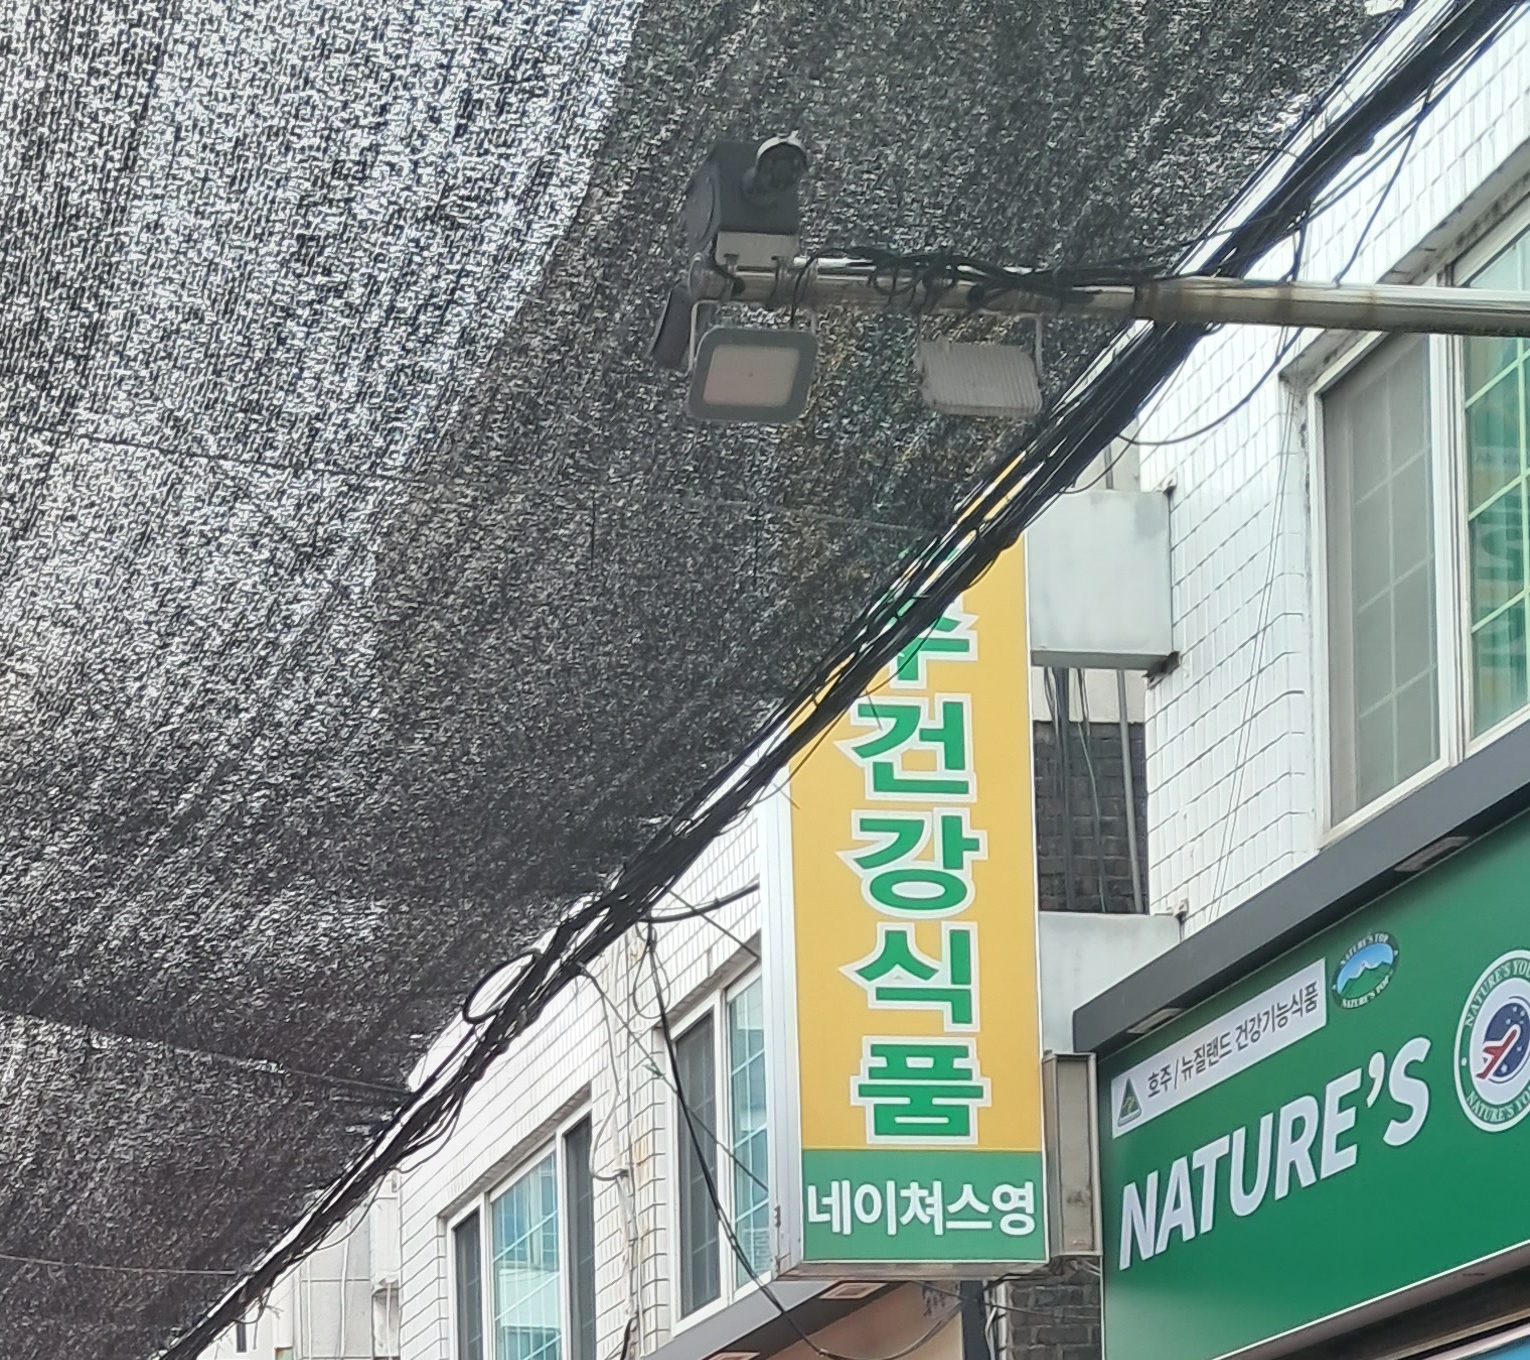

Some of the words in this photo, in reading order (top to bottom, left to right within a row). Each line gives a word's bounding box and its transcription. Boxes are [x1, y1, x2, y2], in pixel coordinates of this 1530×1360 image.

[1235, 982, 1319, 1048] 건강기능식품
[1465, 961, 1511, 1027] NATURE'S
[1119, 1036, 1432, 1271] NATURE'S
[806, 1181, 1037, 1239] 네이쳐스영
